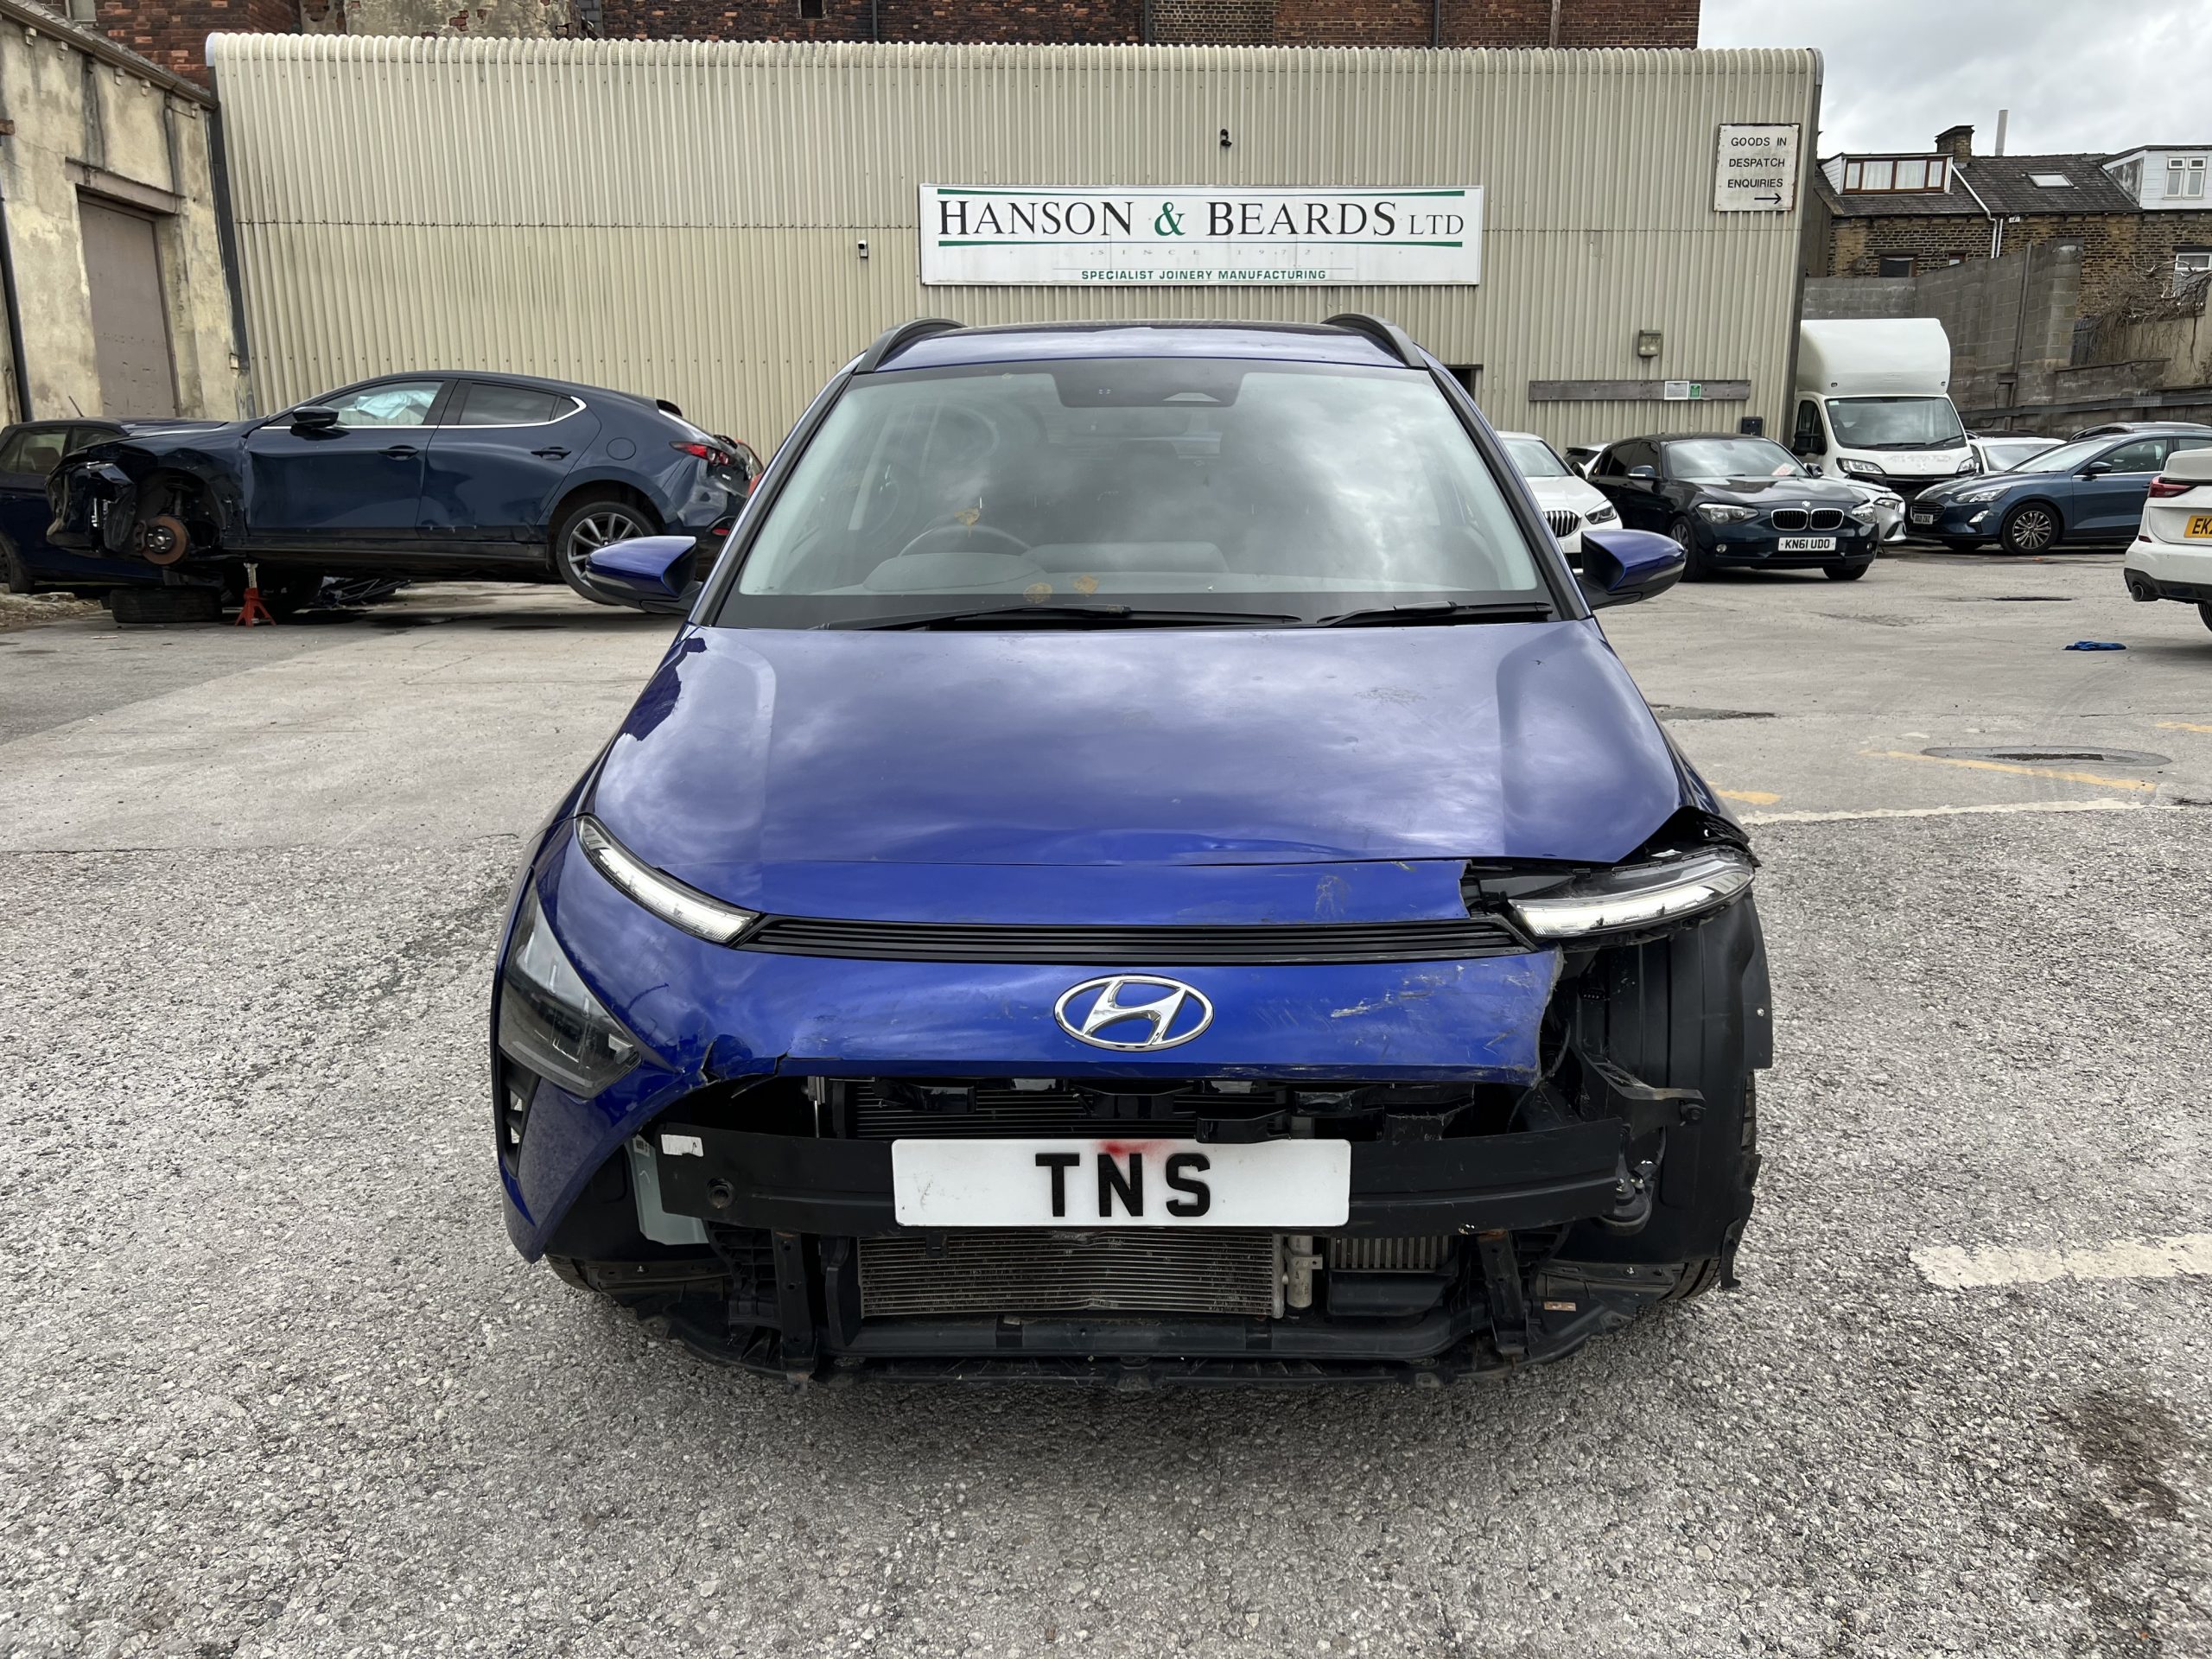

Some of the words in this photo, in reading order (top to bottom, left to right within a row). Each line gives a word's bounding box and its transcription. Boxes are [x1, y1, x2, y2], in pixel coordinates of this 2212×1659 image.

[1731, 137, 1770, 146] GOODS
[1777, 137, 1787, 146] IN
[1729, 157, 1785, 168] DESPATCH
[1727, 178, 1783, 188] ENQUIRIES
[938, 200, 1135, 236] HANSON
[1154, 201, 1186, 237] &
[1206, 200, 1396, 237] BEARDS
[1408, 214, 1465, 235] LTD
[1081, 270, 1154, 280] SPECIALIST
[1159, 270, 1213, 280] JOINERY
[1217, 270, 1326, 280] MANUFACTURING
[1784, 538, 1808, 550] KN61
[1810, 538, 1831, 550] UDO
[1035, 1152, 1211, 1217] TNS
